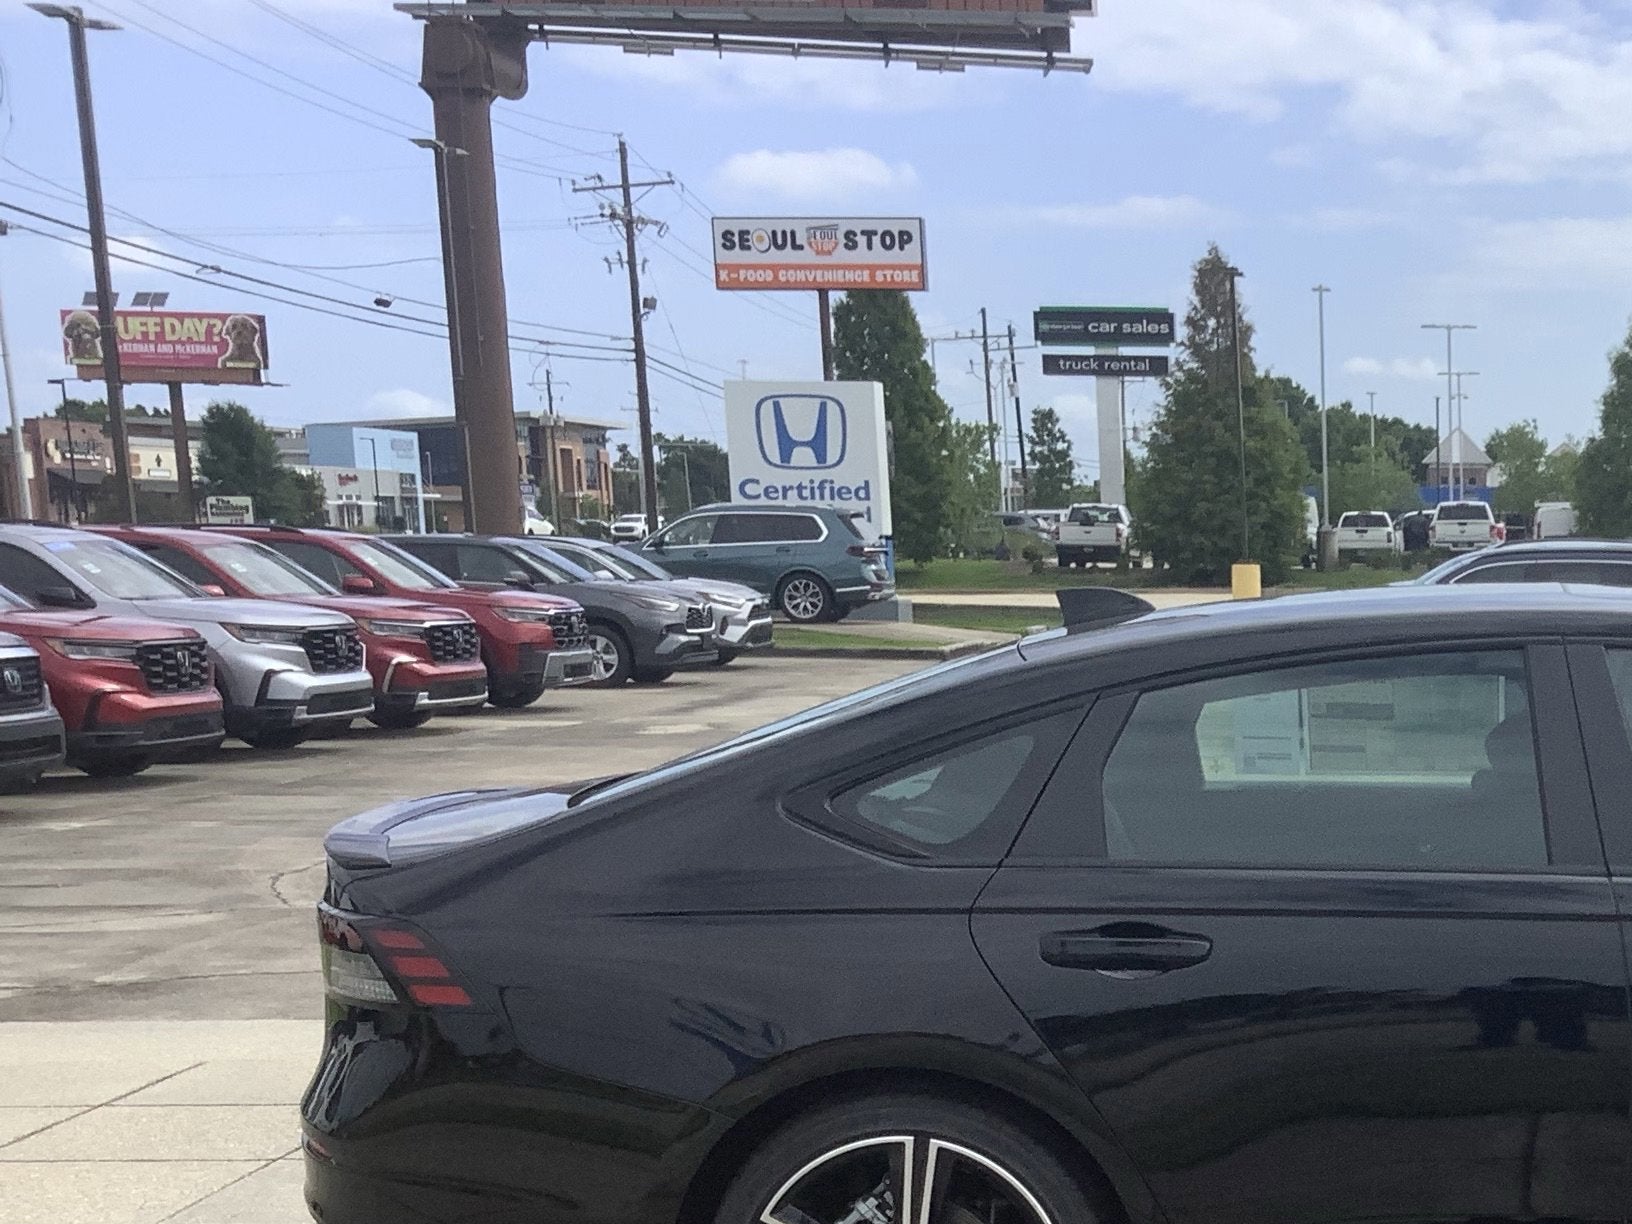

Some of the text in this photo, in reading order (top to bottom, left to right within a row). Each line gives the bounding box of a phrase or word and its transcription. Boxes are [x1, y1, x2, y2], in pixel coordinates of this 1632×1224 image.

[721, 228, 913, 253] SEOUL STOP
[778, 270, 870, 282] CONVENIENCE
[875, 270, 919, 282] STORE
[115, 316, 222, 342] UFF DAY?
[1088, 321, 1117, 333] car
[1122, 319, 1169, 333] sales
[1059, 358, 1150, 371] truck rental
[738, 478, 871, 501] Certified
